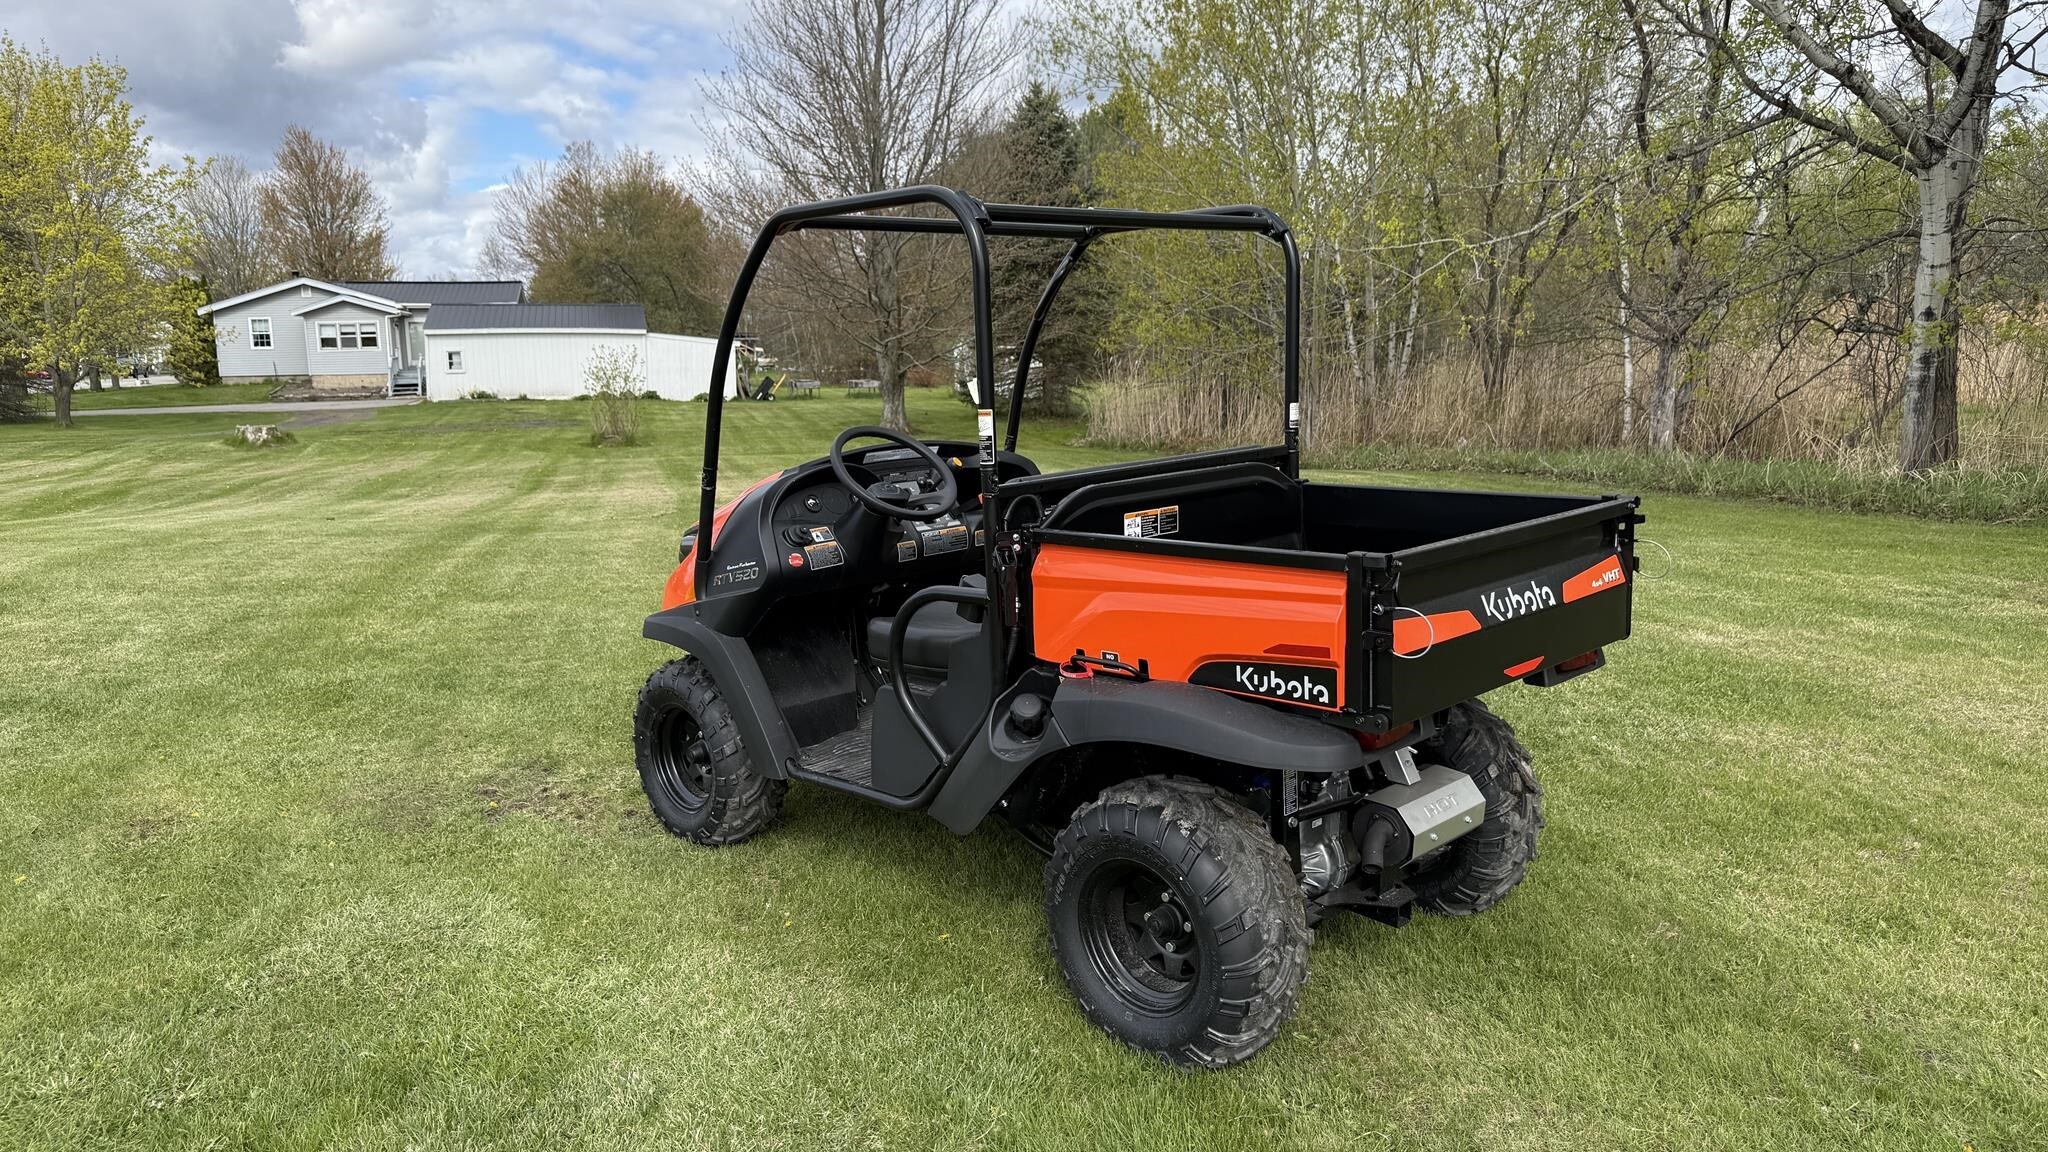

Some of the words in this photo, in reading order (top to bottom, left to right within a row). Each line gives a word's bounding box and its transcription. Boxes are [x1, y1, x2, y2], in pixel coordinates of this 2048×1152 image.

[713, 567, 759, 586] RTV520
[1602, 568, 1620, 583] VHT
[1480, 580, 1556, 621] Kubota
[1236, 665, 1329, 703] Kubota
[1423, 793, 1458, 818] HOT
